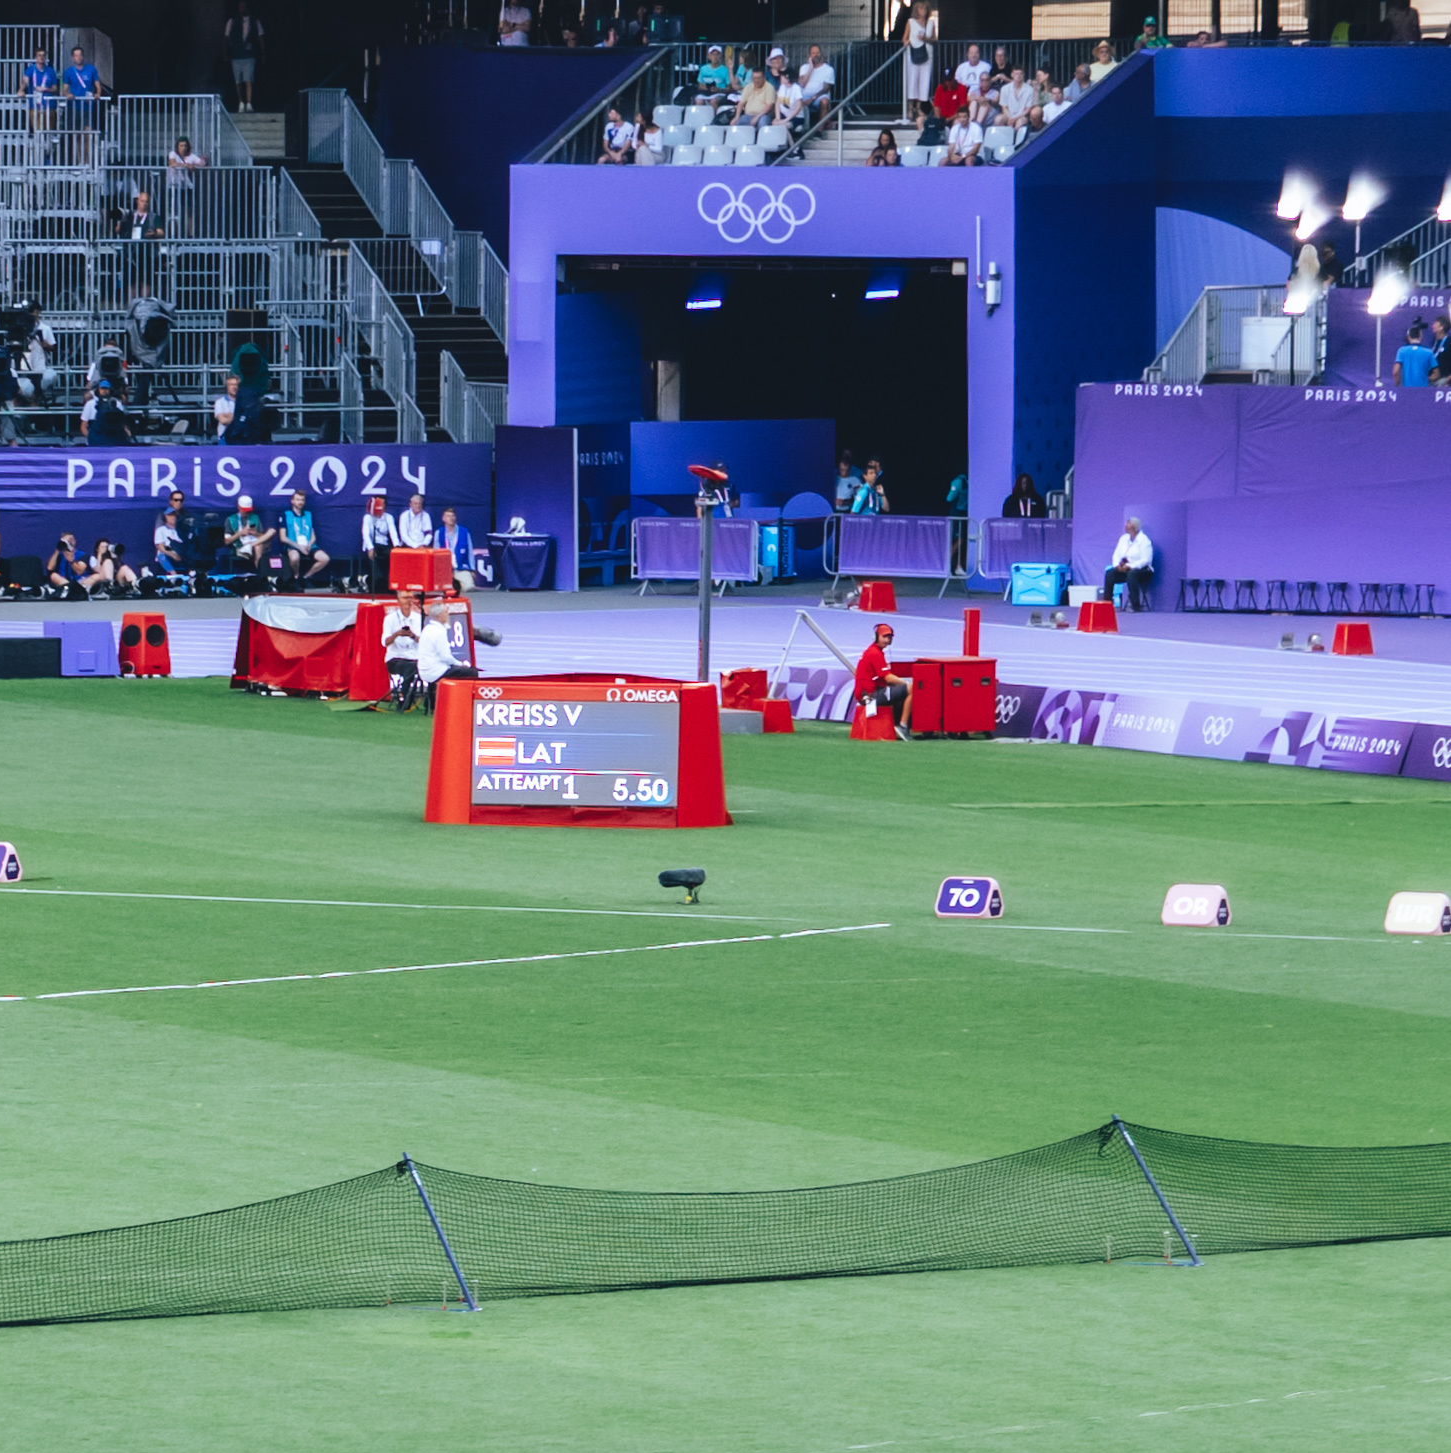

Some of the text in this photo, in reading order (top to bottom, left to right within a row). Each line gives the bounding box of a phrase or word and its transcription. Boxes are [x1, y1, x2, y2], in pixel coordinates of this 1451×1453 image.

[1115, 383, 1204, 397] PARIS 2024
[1305, 388, 1397, 402] PARIS 2024
[67, 455, 426, 498] PARIS 2024
[623, 689, 679, 703] OMEGA
[476, 703, 583, 726] KREISS V
[1113, 712, 1177, 735] PARIS 2024
[517, 741, 567, 765] LAT
[1332, 734, 1402, 756] PARIS 2024
[476, 774, 669, 802] ATTEMPT 1 5.50
[948, 887, 980, 908] 70
[1173, 896, 1210, 916] OR
